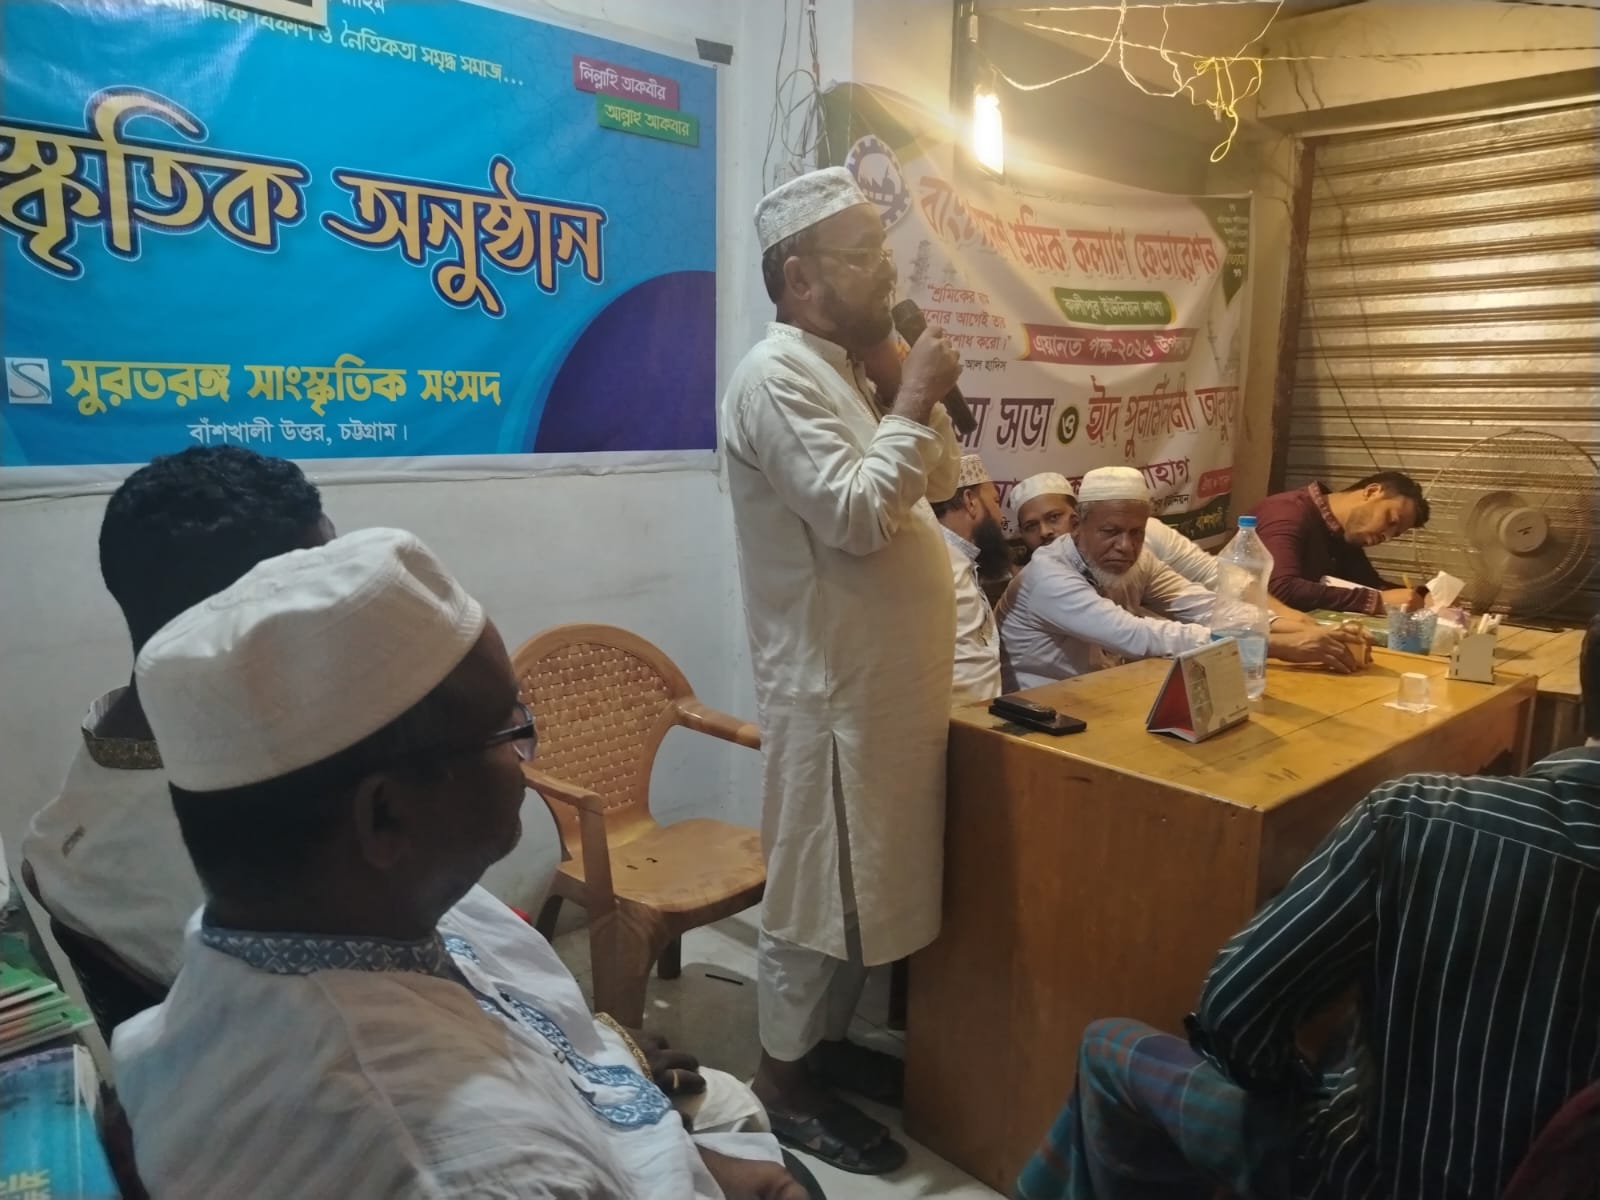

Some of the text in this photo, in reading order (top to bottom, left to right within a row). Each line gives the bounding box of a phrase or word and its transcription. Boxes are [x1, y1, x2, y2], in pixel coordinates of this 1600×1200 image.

[340, 19, 416, 62] নৈতিকতা
[621, 75, 667, 101] তাকবীর
[644, 113, 690, 136] আকবার
[322, 155, 606, 317] অনুষ্ঠান
[62, 353, 502, 416] সুরতরঙ্গ সাংস্কৃতিক সংসদ
[187, 416, 272, 443] বাঁশখালী
[996, 398, 1054, 448] সভা
